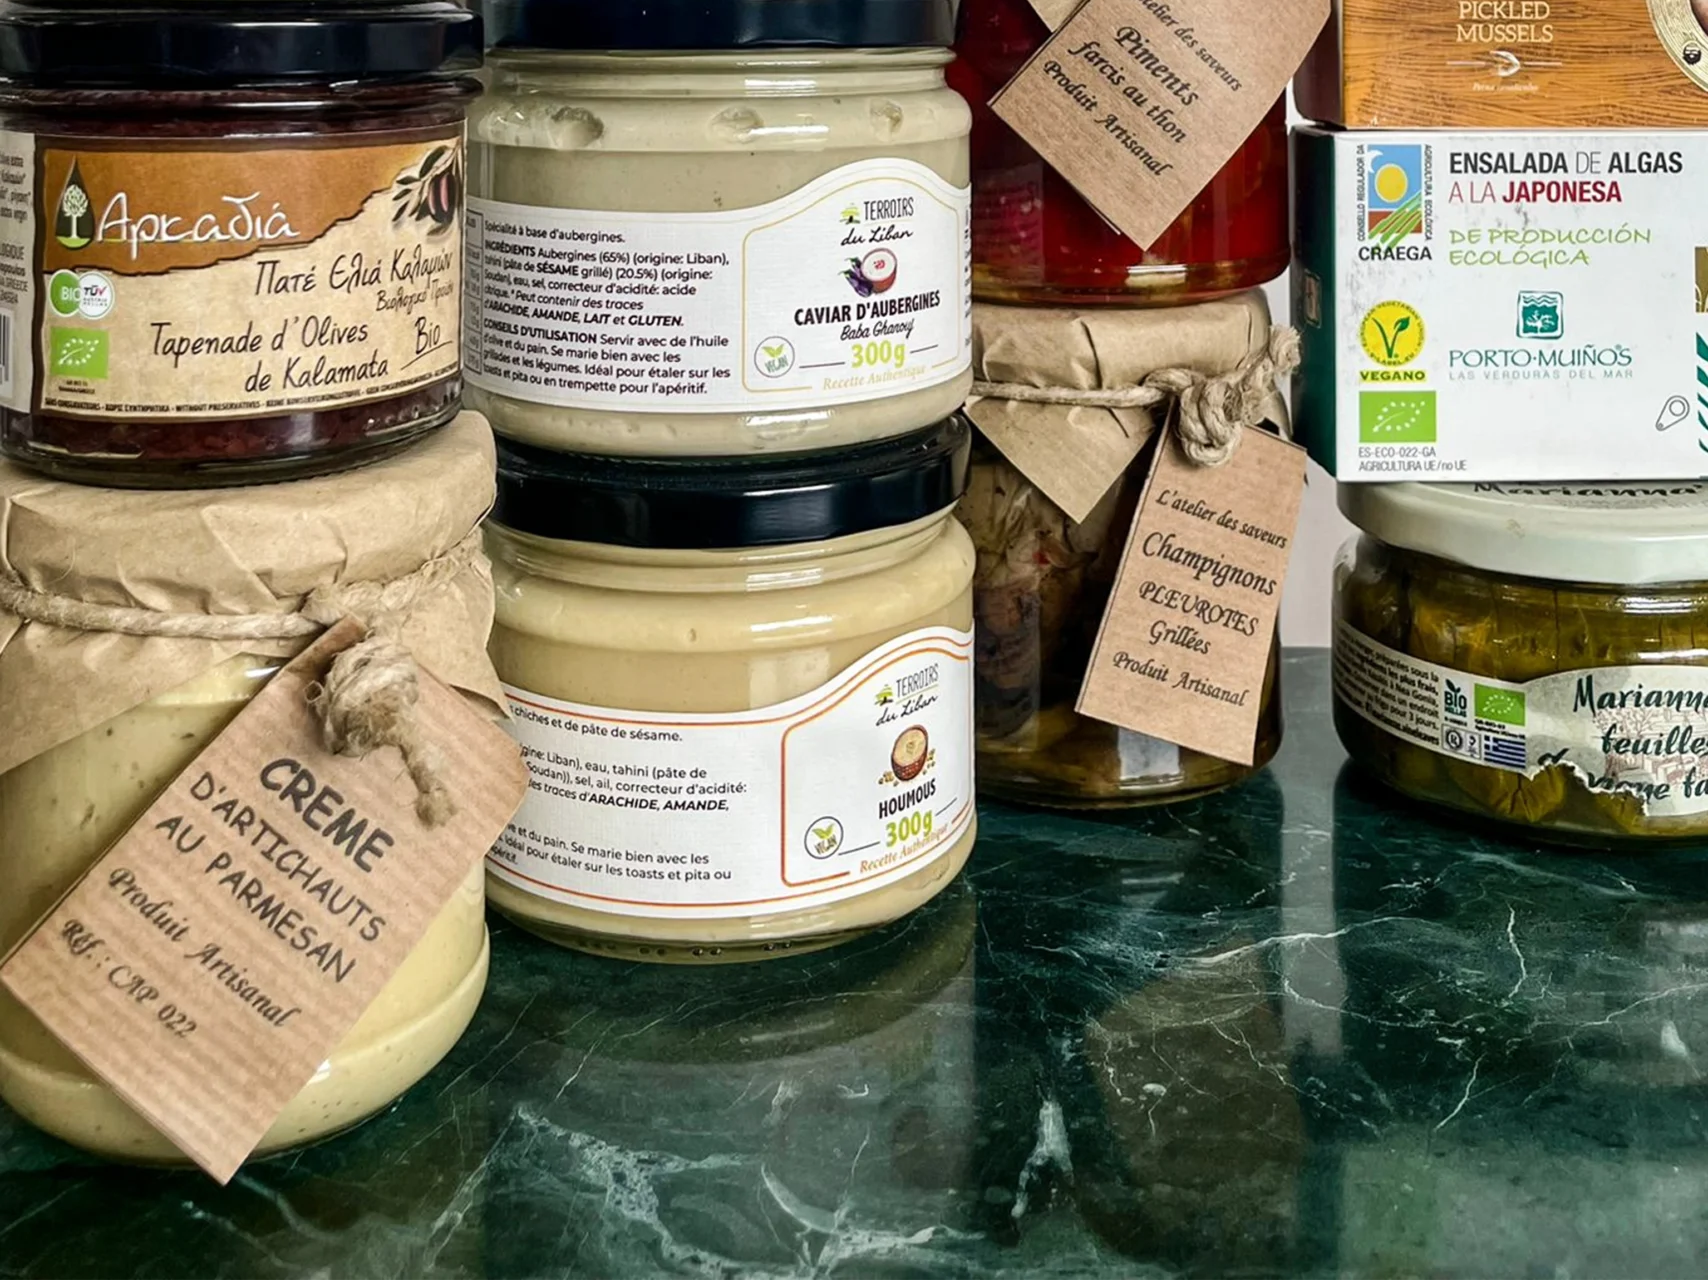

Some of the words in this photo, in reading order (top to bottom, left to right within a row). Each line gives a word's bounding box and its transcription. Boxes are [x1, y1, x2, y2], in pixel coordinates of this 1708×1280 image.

[1458, 1, 1550, 20] PICKLED
[1456, 23, 1554, 43] MUSSELS
[1114, 25, 1199, 107] Piments
[1175, 25, 1198, 49] des
[1195, 47, 1243, 93] saveurs
[1068, 41, 1126, 87] farcis
[1122, 84, 1147, 108] au
[1146, 105, 1187, 145] thon
[1044, 60, 1097, 112] Produit
[1095, 113, 1174, 177] Artisanal
[1449, 151, 1569, 174] ENSALADA
[1576, 151, 1601, 174] DE
[1607, 151, 1683, 175] ALGAS
[1448, 181, 1464, 204] A
[1470, 181, 1496, 204] LA
[1502, 181, 1622, 204] JAPONESA
[863, 196, 914, 222] TERROIRS
[840, 227, 865, 246] du
[868, 224, 914, 243] Liban
[1449, 229, 1484, 245] DE
[1488, 223, 1651, 245] PRODUCCIÓN
[538, 248, 597, 263] Aubergines
[1358, 246, 1432, 261] CRAEGA
[1449, 244, 1590, 269] ECOLÓGICA
[61, 286, 81, 301] BIO
[662, 284, 697, 296] acide
[605, 299, 644, 311] traces
[794, 305, 851, 326] CAVIAR
[856, 290, 941, 321] D'AUBERGINES
[151, 321, 262, 368] Tapenade
[414, 317, 441, 355] Bio
[600, 334, 635, 346] Servir
[637, 337, 667, 347] avec
[840, 324, 870, 341] Baba
[601, 350, 628, 361] bien
[630, 353, 660, 362] avec
[764, 355, 789, 374] VEGAN
[851, 340, 906, 369] 300g
[244, 357, 271, 392] de
[282, 349, 389, 389] Kalamata
[823, 375, 865, 391] Recette
[867, 364, 928, 386] Authentique
[1360, 370, 1426, 381] VEGANO
[1449, 371, 1475, 380] LAS
[1484, 370, 1560, 380] VERDURAS
[1569, 370, 1596, 380] DEL
[1603, 369, 1633, 379] MAR
[559, 380, 617, 392] trempette
[1358, 447, 1436, 459] ES-ECO-022-GA
[1358, 460, 1423, 472] AGRICULTURA
[1155, 489, 1217, 522] L'atelier
[1217, 510, 1238, 531] des
[1238, 524, 1289, 549] saveurs
[1142, 531, 1278, 597] Champignons
[1138, 581, 1259, 637] PLEUROTES
[1149, 620, 1212, 655] Grillées
[895, 663, 939, 698] TERROIRS
[1113, 651, 1169, 683] Produit
[1172, 671, 1250, 707] Artisanal
[876, 707, 898, 726] du
[901, 693, 938, 719] Liban
[1444, 690, 1467, 710] BIO
[612, 764, 649, 777] tahini
[615, 781, 683, 794] correcteur
[878, 778, 936, 820] HOUMOUS
[258, 757, 395, 873] CREME
[885, 809, 933, 848] 300g
[190, 771, 388, 943] D'ARTICHAUTS
[813, 835, 839, 855] VEGAN
[859, 853, 897, 874] Recette
[899, 823, 949, 859] Authentique
[626, 867, 665, 880] toasts
[155, 814, 206, 854] AU
[205, 851, 356, 984] PARMESAN
[109, 867, 191, 943] Produit
[184, 942, 302, 1028] Artisanal
[157, 1002, 199, 1039] 022
